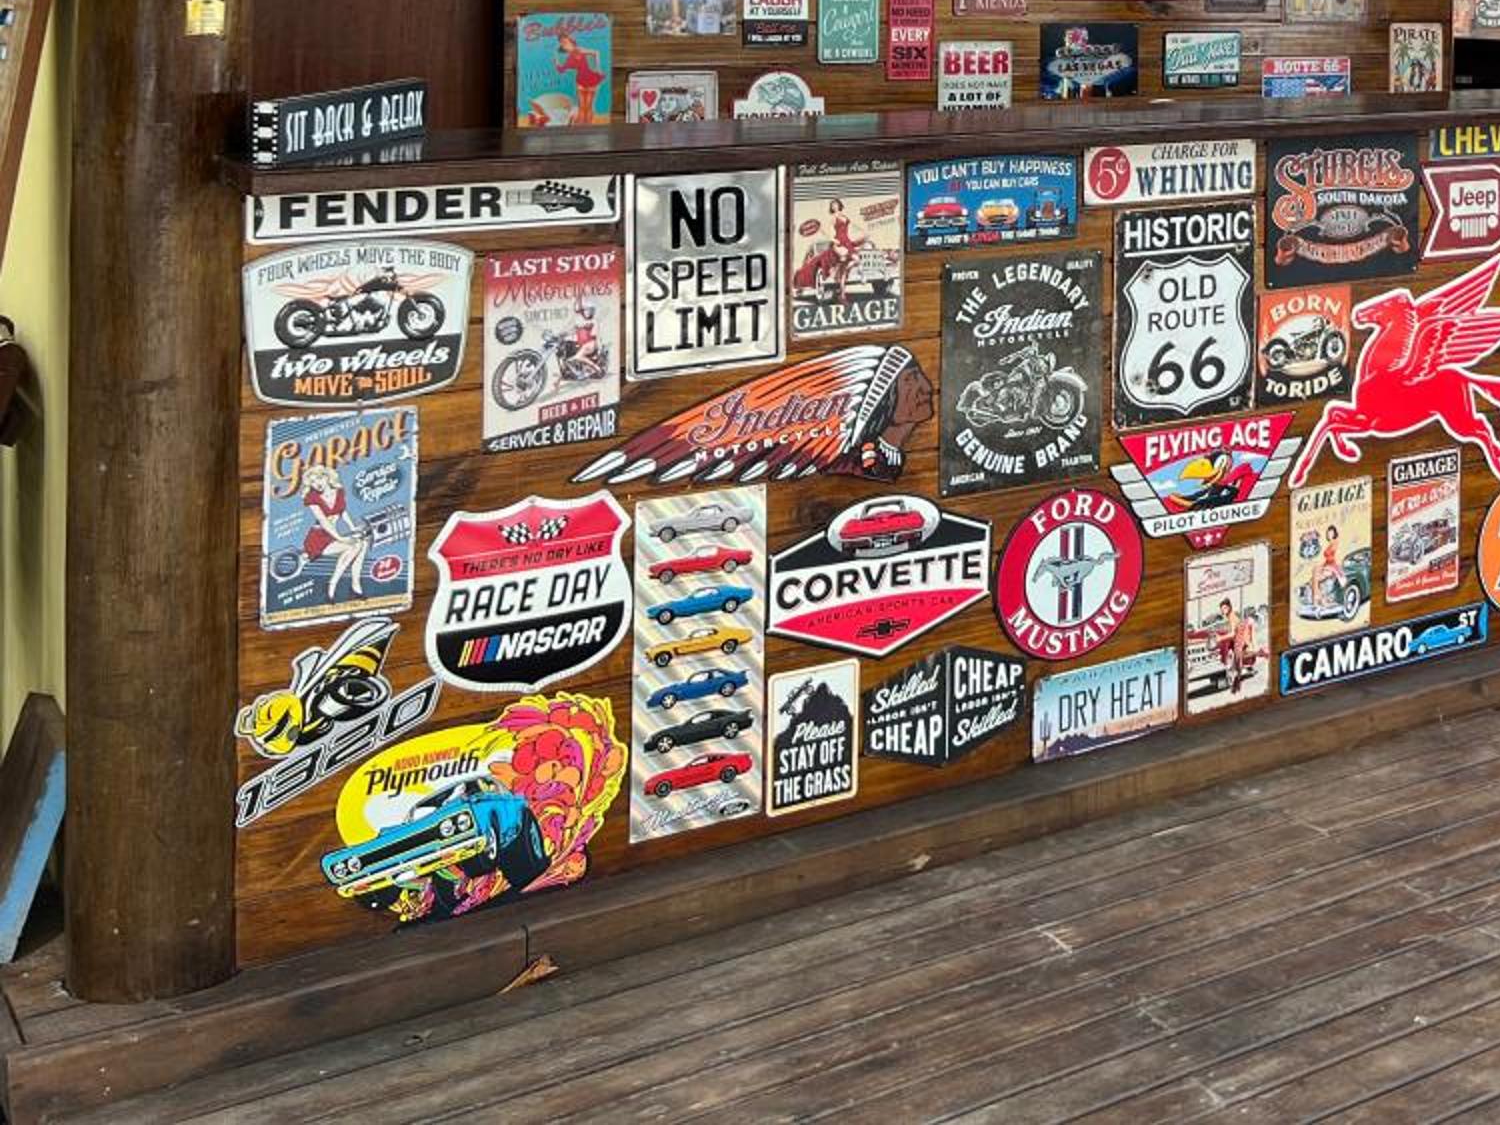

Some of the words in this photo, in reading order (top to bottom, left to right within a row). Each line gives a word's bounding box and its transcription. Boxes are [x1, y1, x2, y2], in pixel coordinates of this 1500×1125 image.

[891, 27, 931, 43] EVERY
[1393, 26, 1439, 44] PIRATE
[891, 46, 927, 60] SIX
[943, 50, 1010, 76] BEER
[1273, 60, 1322, 75] ROUTE
[1323, 61, 1340, 73] 66
[947, 92, 957, 102] A
[960, 92, 983, 102] LOT
[985, 92, 1003, 102] OF
[1150, 142, 1210, 162] CHARGE
[1212, 140, 1240, 158] FOR
[913, 169, 939, 187] YOU
[941, 162, 977, 181] CAN'T
[981, 160, 1005, 177] BUY
[1009, 158, 1073, 178] HAPPINESS
[1136, 159, 1252, 198] WHINING
[278, 186, 502, 230] FENDER
[1316, 190, 1358, 205] SOUTH
[1358, 190, 1409, 206] DAKOTA
[1451, 185, 1497, 210] Jeep
[671, 186, 745, 250] NO
[1124, 210, 1251, 252] HISTORIC
[257, 260, 295, 286] FOUR
[297, 249, 351, 276] WHEELS
[355, 247, 395, 268] MOVE
[398, 248, 424, 267] THE
[429, 251, 461, 274] BODY
[493, 256, 552, 278] LAST
[556, 251, 615, 274] STOP
[646, 253, 767, 302] SPEED
[494, 280, 613, 315] Motorcycles
[1158, 273, 1218, 304] OLD
[646, 297, 768, 353] LIMIT
[793, 298, 898, 331] GARAGE
[973, 304, 1073, 340] Indian
[1149, 304, 1226, 334] ROUTE
[1269, 293, 1343, 324] BORN
[977, 330, 1070, 348] MOTORCYCLE
[1147, 335, 1226, 396] 66
[1144, 424, 1224, 469] FLYING
[1229, 416, 1272, 449] ACE
[1393, 453, 1459, 483] GARAGE
[1297, 480, 1369, 514] GARAGE
[1152, 512, 1196, 533] PILOT
[1198, 502, 1262, 526] LOUNGE
[462, 556, 518, 575] THERE'S
[522, 552, 542, 568] NO
[545, 546, 572, 565] DAY
[575, 540, 607, 557] LIKE
[445, 580, 537, 626] RACE
[546, 563, 612, 611] DAY
[775, 549, 982, 611] CORVETTE
[807, 607, 874, 628] AMERICAN
[877, 599, 927, 614] SPORTS
[932, 594, 955, 608] CAR
[496, 615, 608, 665] NASCAR
[1293, 625, 1413, 686] CAMARO
[1457, 609, 1479, 629] ST
[868, 664, 938, 715] Skilled
[954, 697, 988, 714] LABOR
[988, 689, 1013, 704] ISN'T
[1058, 688, 1102, 735] DRY
[1110, 670, 1167, 717] HEAT
[871, 708, 908, 724] LABOR
[909, 699, 938, 716] ISN'T
[951, 703, 1018, 749] Skilled
[791, 719, 846, 743] Please
[395, 756, 420, 770] ROAD
[779, 742, 818, 776] STAY
[819, 737, 846, 767] OFF
[773, 774, 803, 807] THE
[803, 765, 852, 801] GRASS
